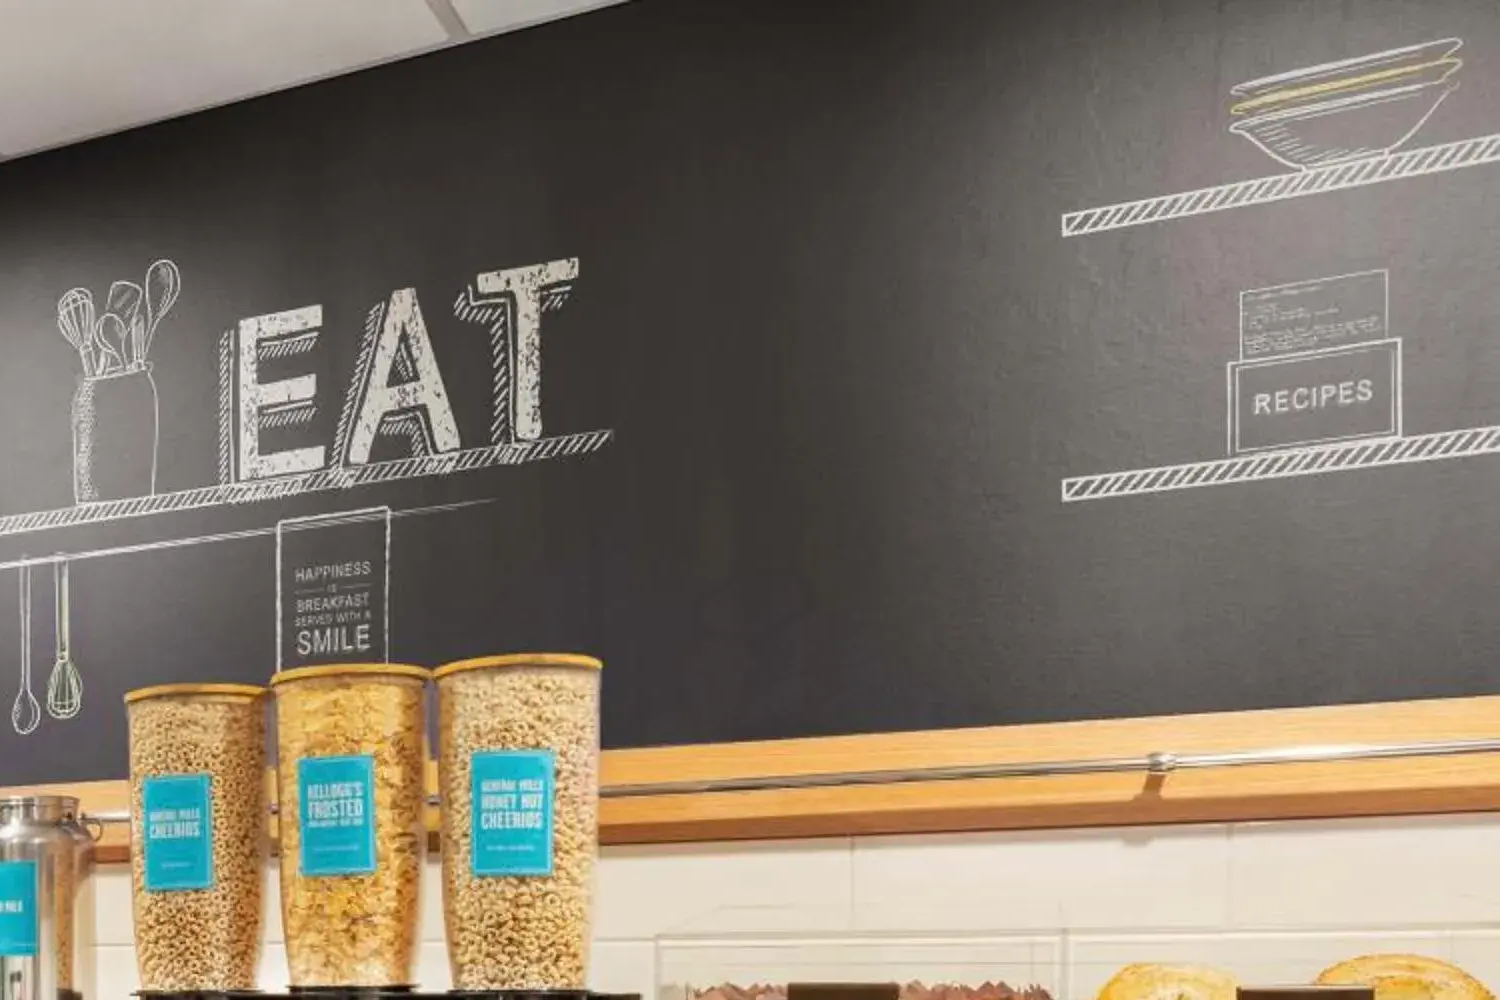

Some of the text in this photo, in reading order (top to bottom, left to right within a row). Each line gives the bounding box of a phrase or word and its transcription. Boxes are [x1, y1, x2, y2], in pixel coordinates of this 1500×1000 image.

[220, 256, 580, 484] EAT
[1253, 378, 1375, 416] RECIPES
[295, 560, 372, 582] HAPPINESS
[297, 591, 370, 613] BREAKFAST
[296, 623, 371, 655] SMILE
[307, 798, 364, 820] FROSTED
[149, 819, 202, 840] CHEERIOS
[481, 811, 544, 831] CHEERIOS
